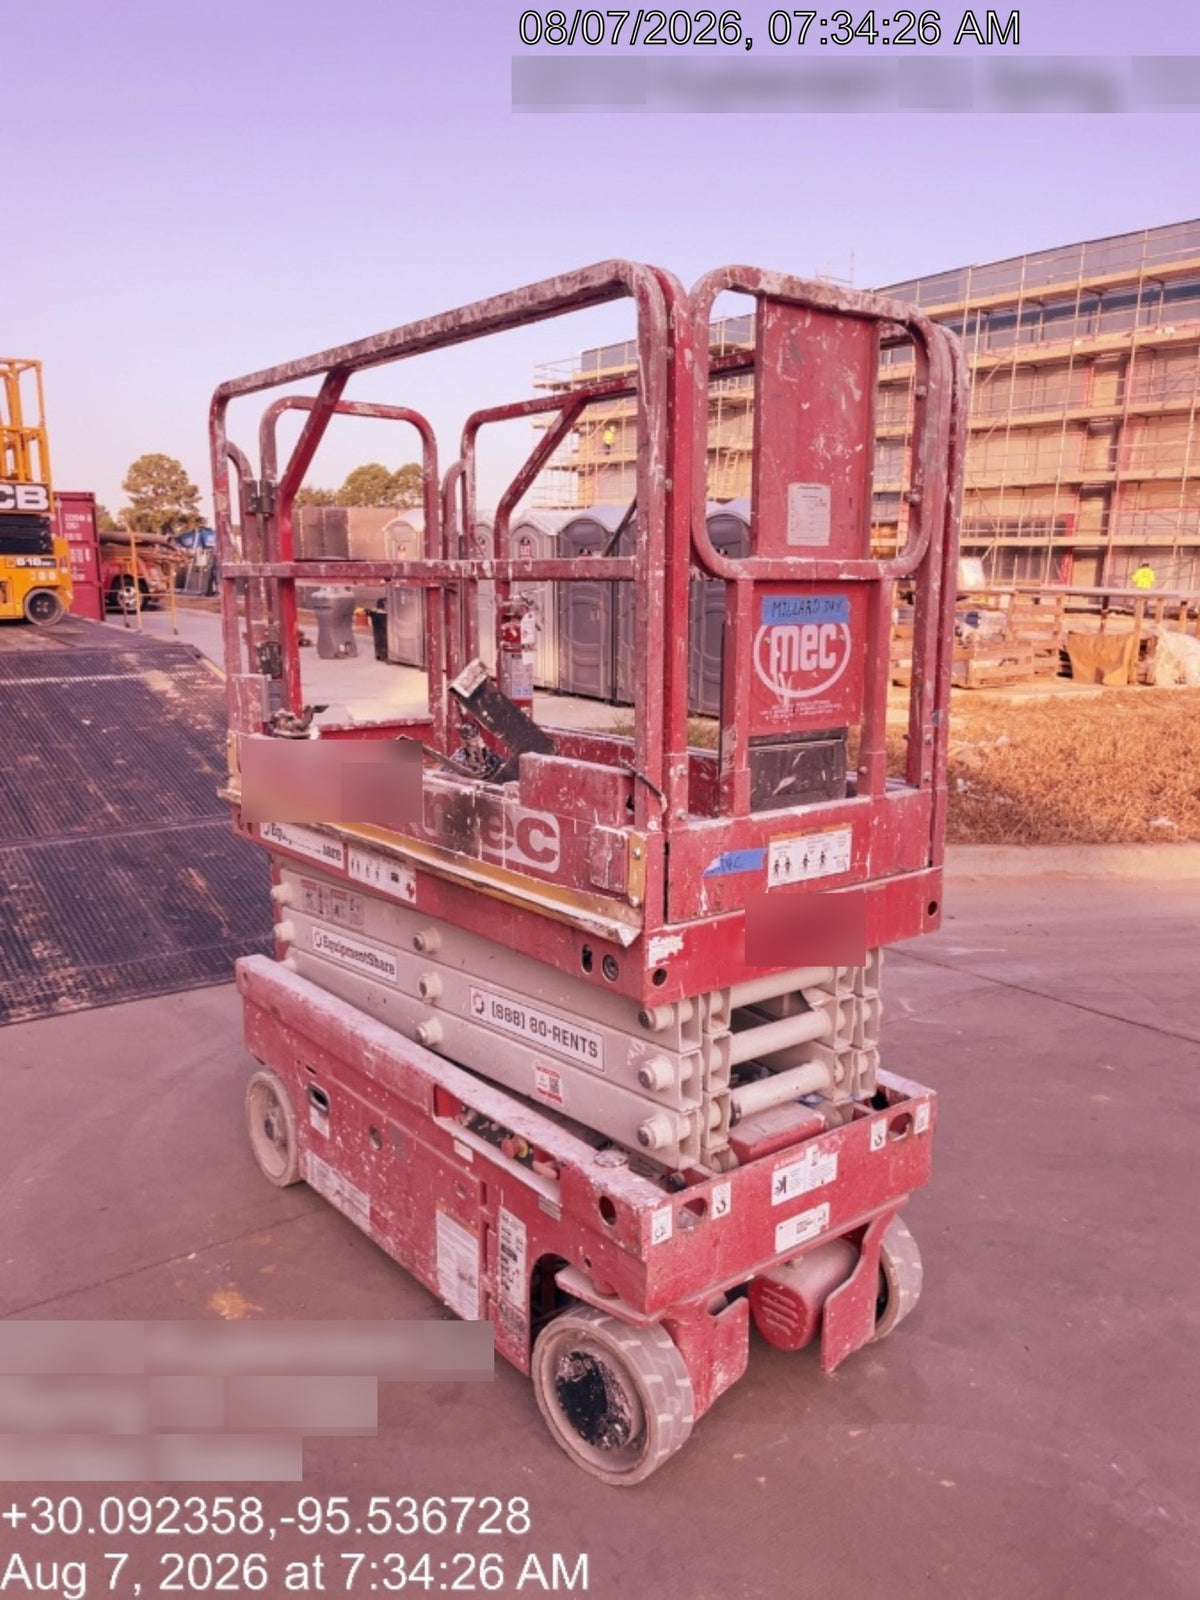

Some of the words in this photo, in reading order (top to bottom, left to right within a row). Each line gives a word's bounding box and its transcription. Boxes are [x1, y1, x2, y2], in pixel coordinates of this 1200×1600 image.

[323, 935, 395, 975] EquipmentShare
[491, 1001, 526, 1029] (888)
[529, 1016, 598, 1058] 80-RENTS
